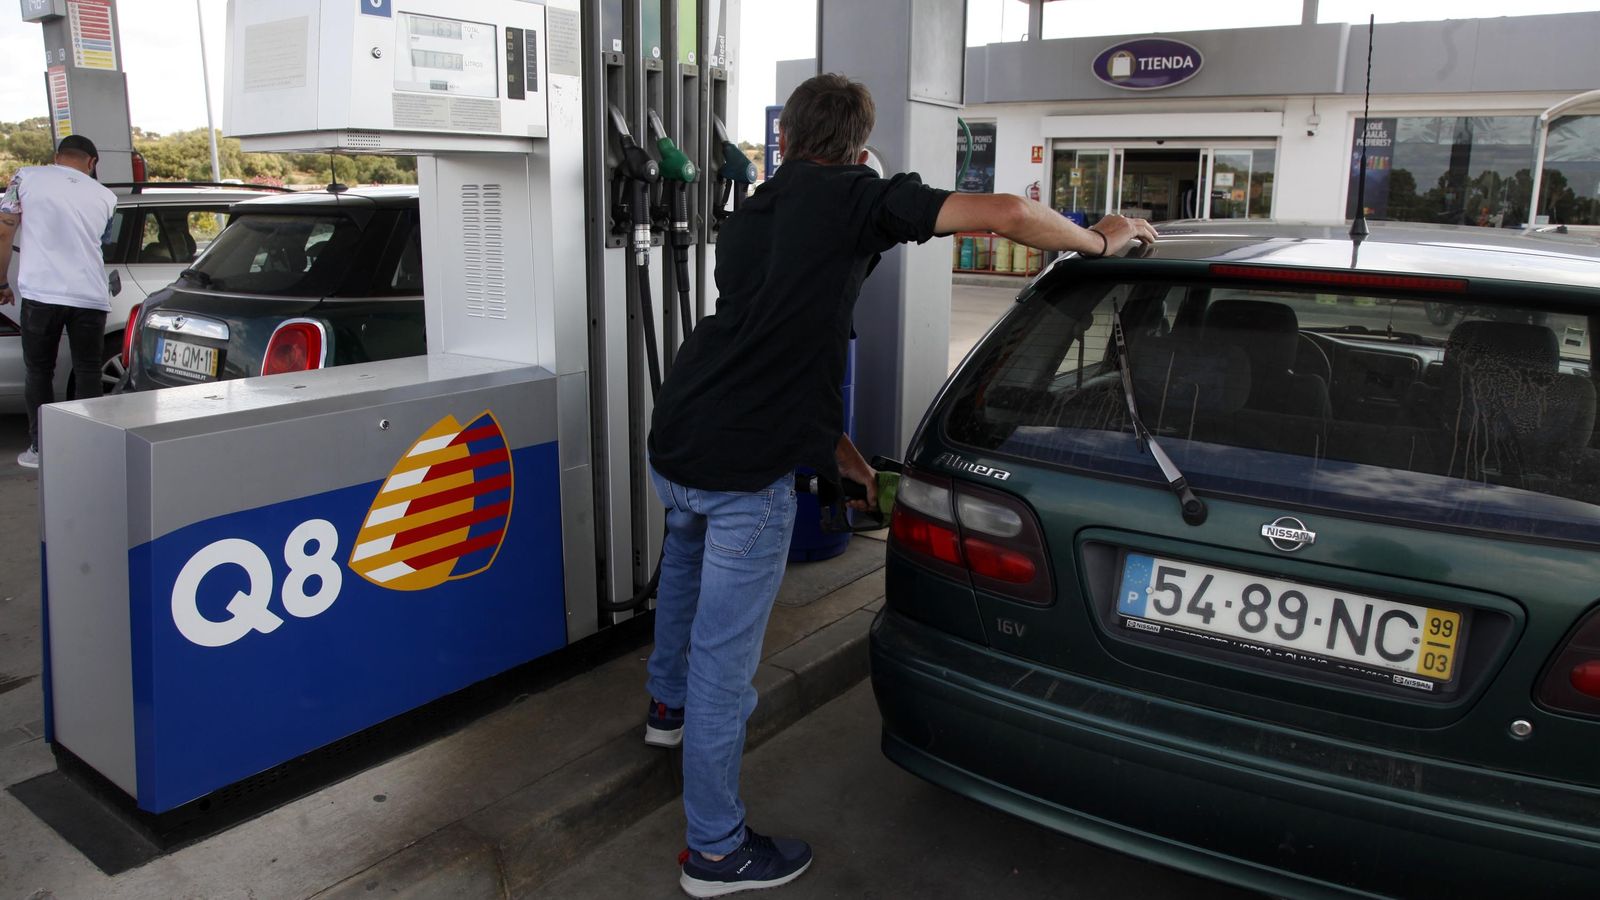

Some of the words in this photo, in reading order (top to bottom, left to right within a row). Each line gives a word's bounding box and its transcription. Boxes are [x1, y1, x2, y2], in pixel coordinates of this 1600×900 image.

[718, 35, 726, 65] Diesel
[1138, 55, 1194, 71] TIENDA
[974, 135, 993, 143] PONES
[960, 143, 987, 151] MACHA?
[1266, 527, 1310, 540] NISSAN
[171, 518, 343, 647] Q8
[1127, 591, 1139, 604] P
[996, 617, 1025, 637] 16V
[1136, 622, 1159, 632] NISSAN
[1429, 617, 1454, 638] 99
[1423, 652, 1448, 673] 03
[1404, 678, 1432, 690] NISSAN
